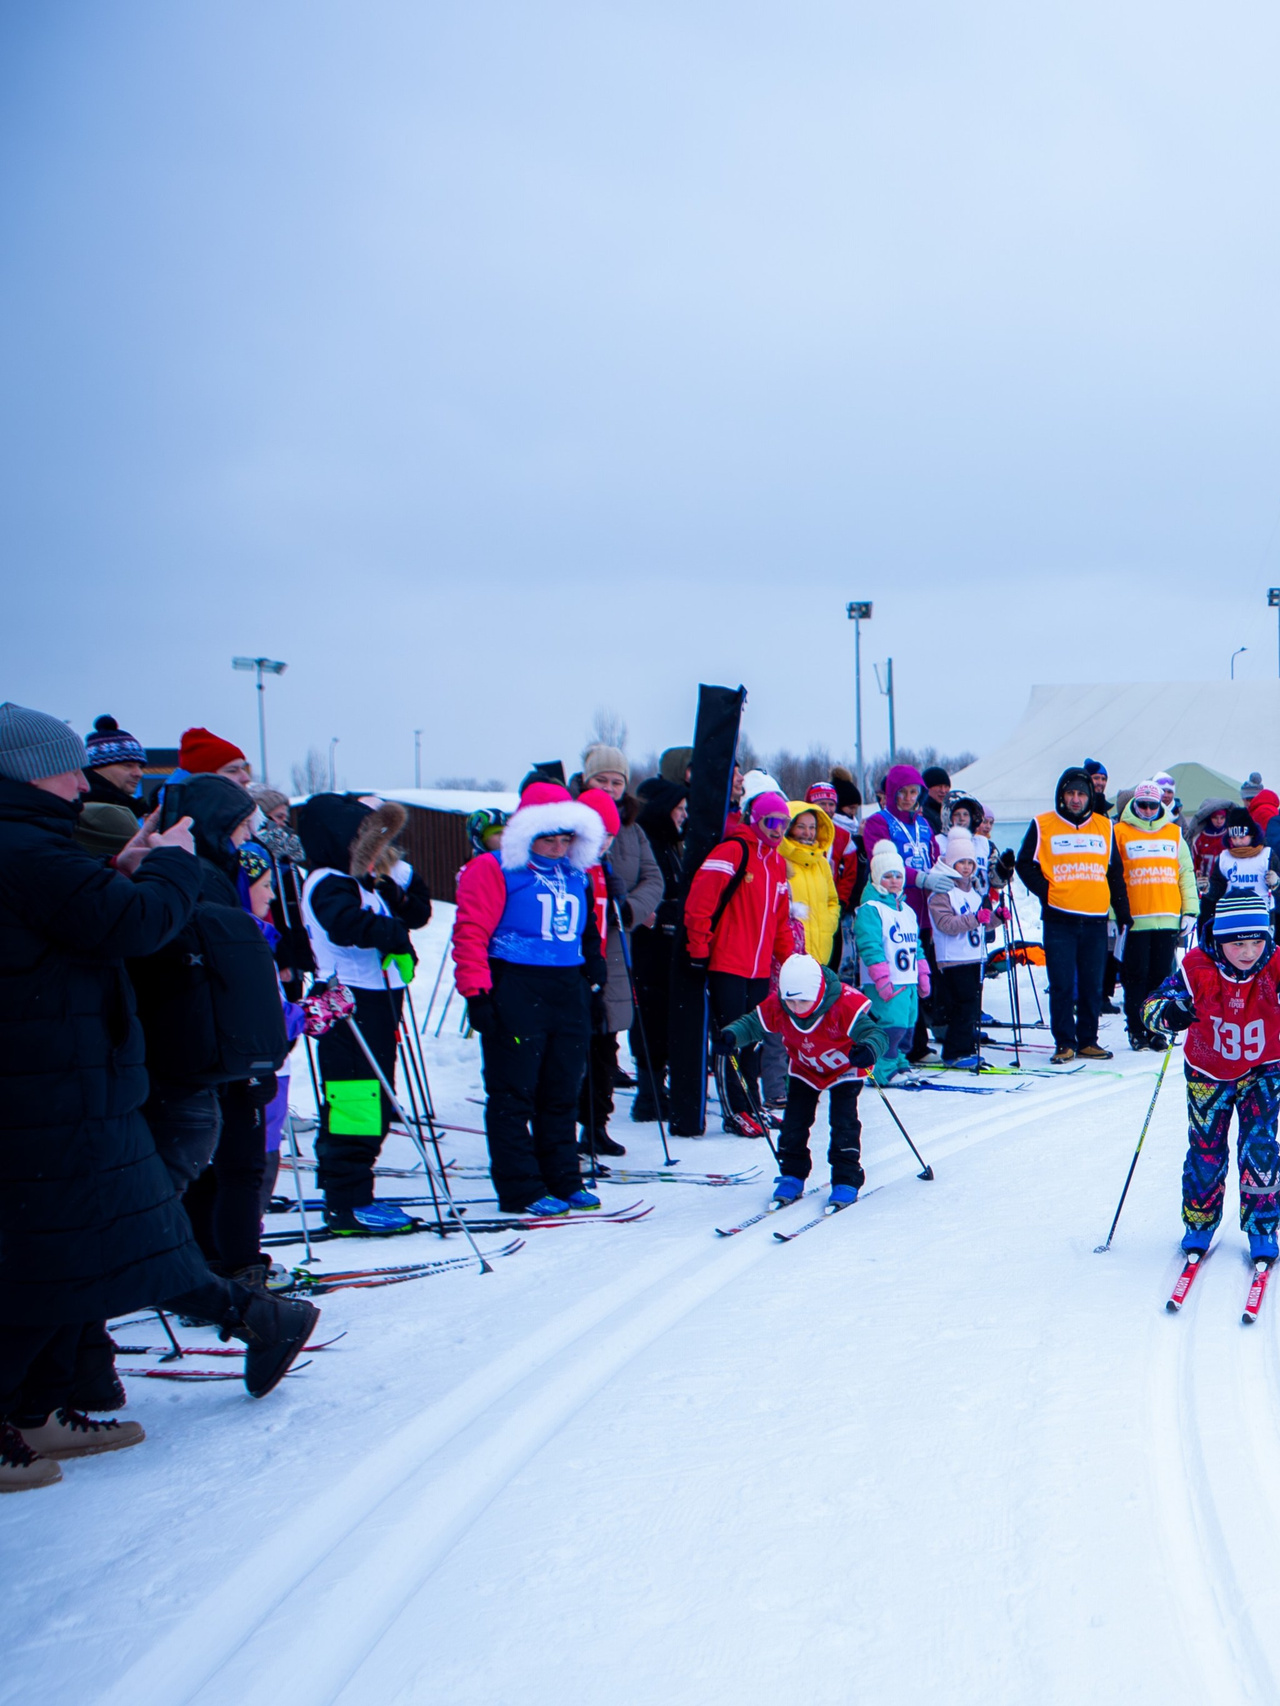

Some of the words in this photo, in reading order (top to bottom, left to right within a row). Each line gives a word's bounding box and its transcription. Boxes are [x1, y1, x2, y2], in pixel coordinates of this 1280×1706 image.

[1228, 826, 1249, 837] WOLF
[1053, 862, 1106, 875] КОМАНДА
[1129, 866, 1177, 878] КОМАНДА
[894, 947, 917, 972] 67
[1209, 1015, 1266, 1062] 139
